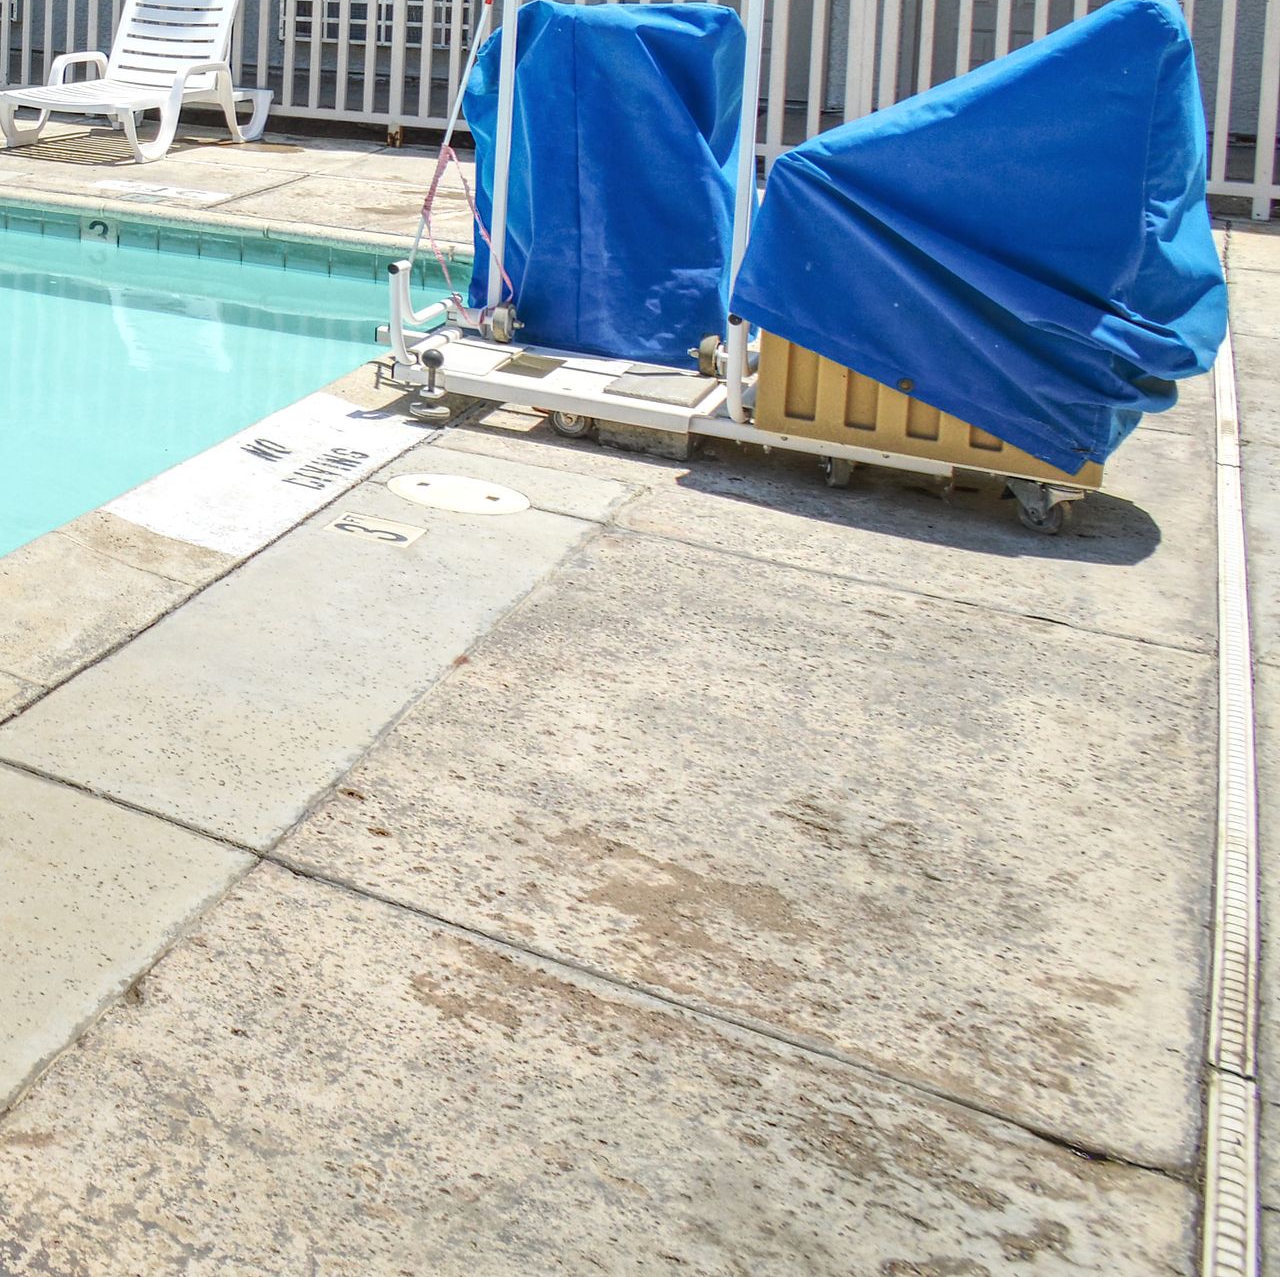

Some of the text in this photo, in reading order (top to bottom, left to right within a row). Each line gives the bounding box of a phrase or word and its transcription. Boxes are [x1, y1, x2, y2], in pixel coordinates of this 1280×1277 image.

[240, 438, 293, 462] NO
[281, 447, 370, 490] DIVING
[334, 523, 408, 542] 3
